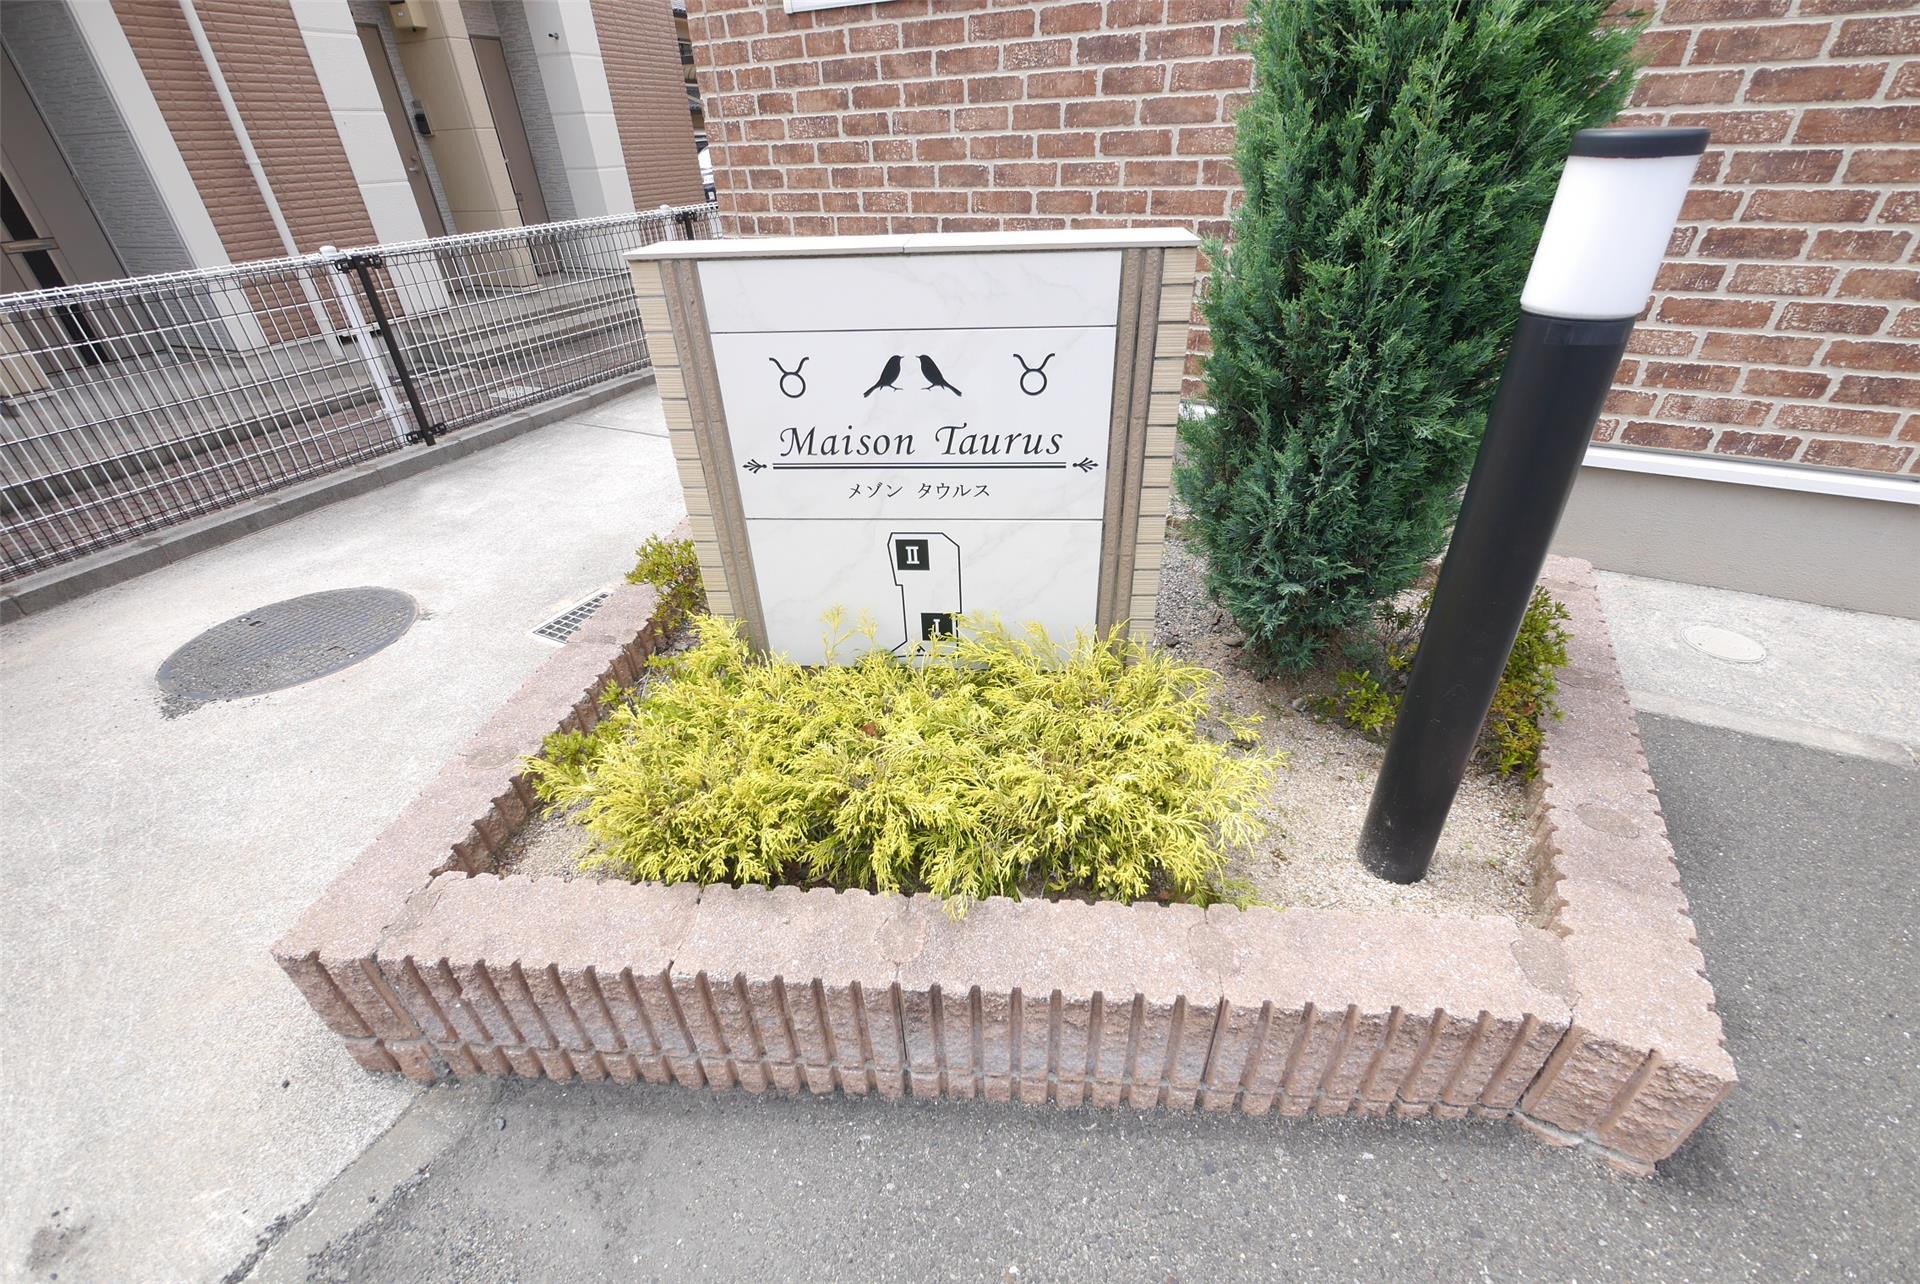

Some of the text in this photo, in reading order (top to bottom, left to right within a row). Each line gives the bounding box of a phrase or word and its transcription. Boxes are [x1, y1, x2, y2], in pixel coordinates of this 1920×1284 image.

[779, 422, 1064, 457] Maison Taurus
[848, 481, 991, 500] メゾン タウルス
